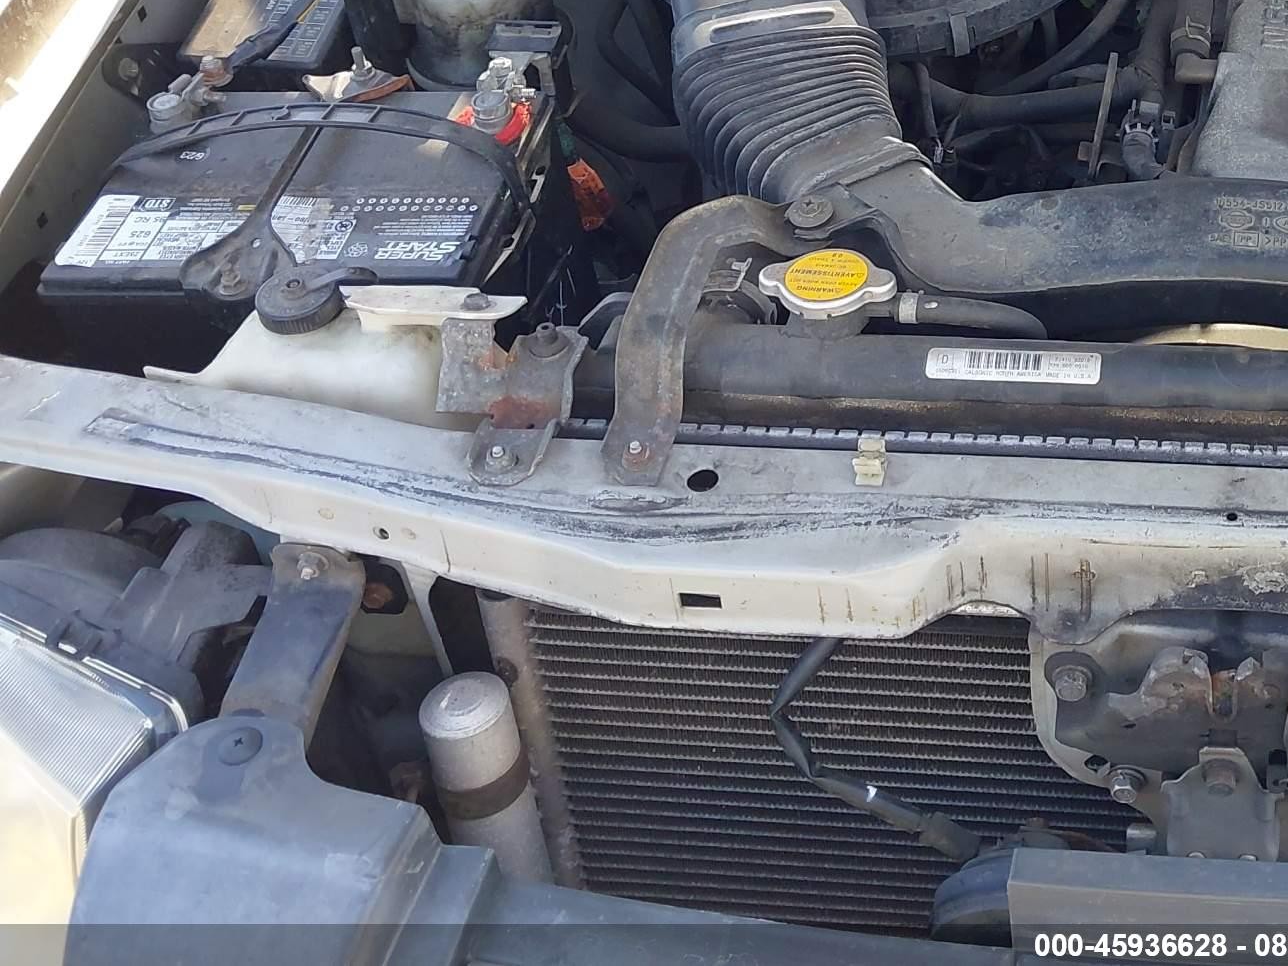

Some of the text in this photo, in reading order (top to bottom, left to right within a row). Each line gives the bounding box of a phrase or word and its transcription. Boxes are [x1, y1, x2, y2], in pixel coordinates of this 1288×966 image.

[129, 230, 152, 238] 625
[376, 240, 461, 253] START
[374, 250, 445, 261] SUPER
[795, 284, 835, 294] WARNING
[941, 354, 949, 364] D
